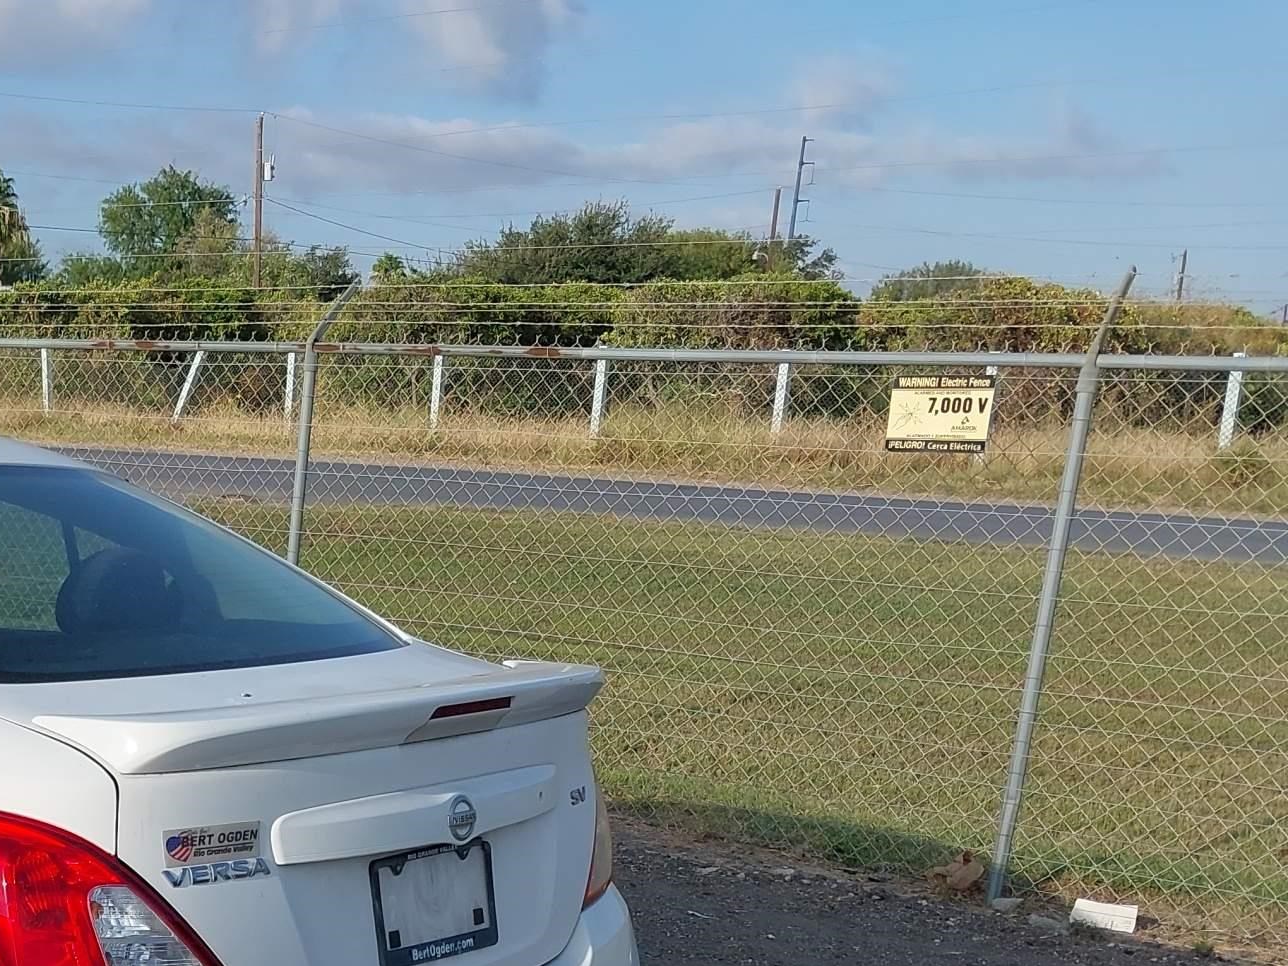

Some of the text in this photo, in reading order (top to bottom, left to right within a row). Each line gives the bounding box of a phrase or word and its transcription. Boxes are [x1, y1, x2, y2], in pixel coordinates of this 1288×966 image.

[898, 376, 991, 388] WARNING! Electric Fence
[927, 397, 989, 416] 7,000 V
[927, 442, 949, 451] Cerca
[949, 442, 982, 451] Eléctrica
[569, 786, 586, 806] SV
[453, 810, 476, 825] NISSAN
[182, 833, 215, 848] BERT
[218, 829, 258, 844] OGDEN
[193, 844, 255, 857] Rio Grande Valley
[161, 857, 271, 888] VERSA
[412, 936, 475, 961] BertOgden.com
